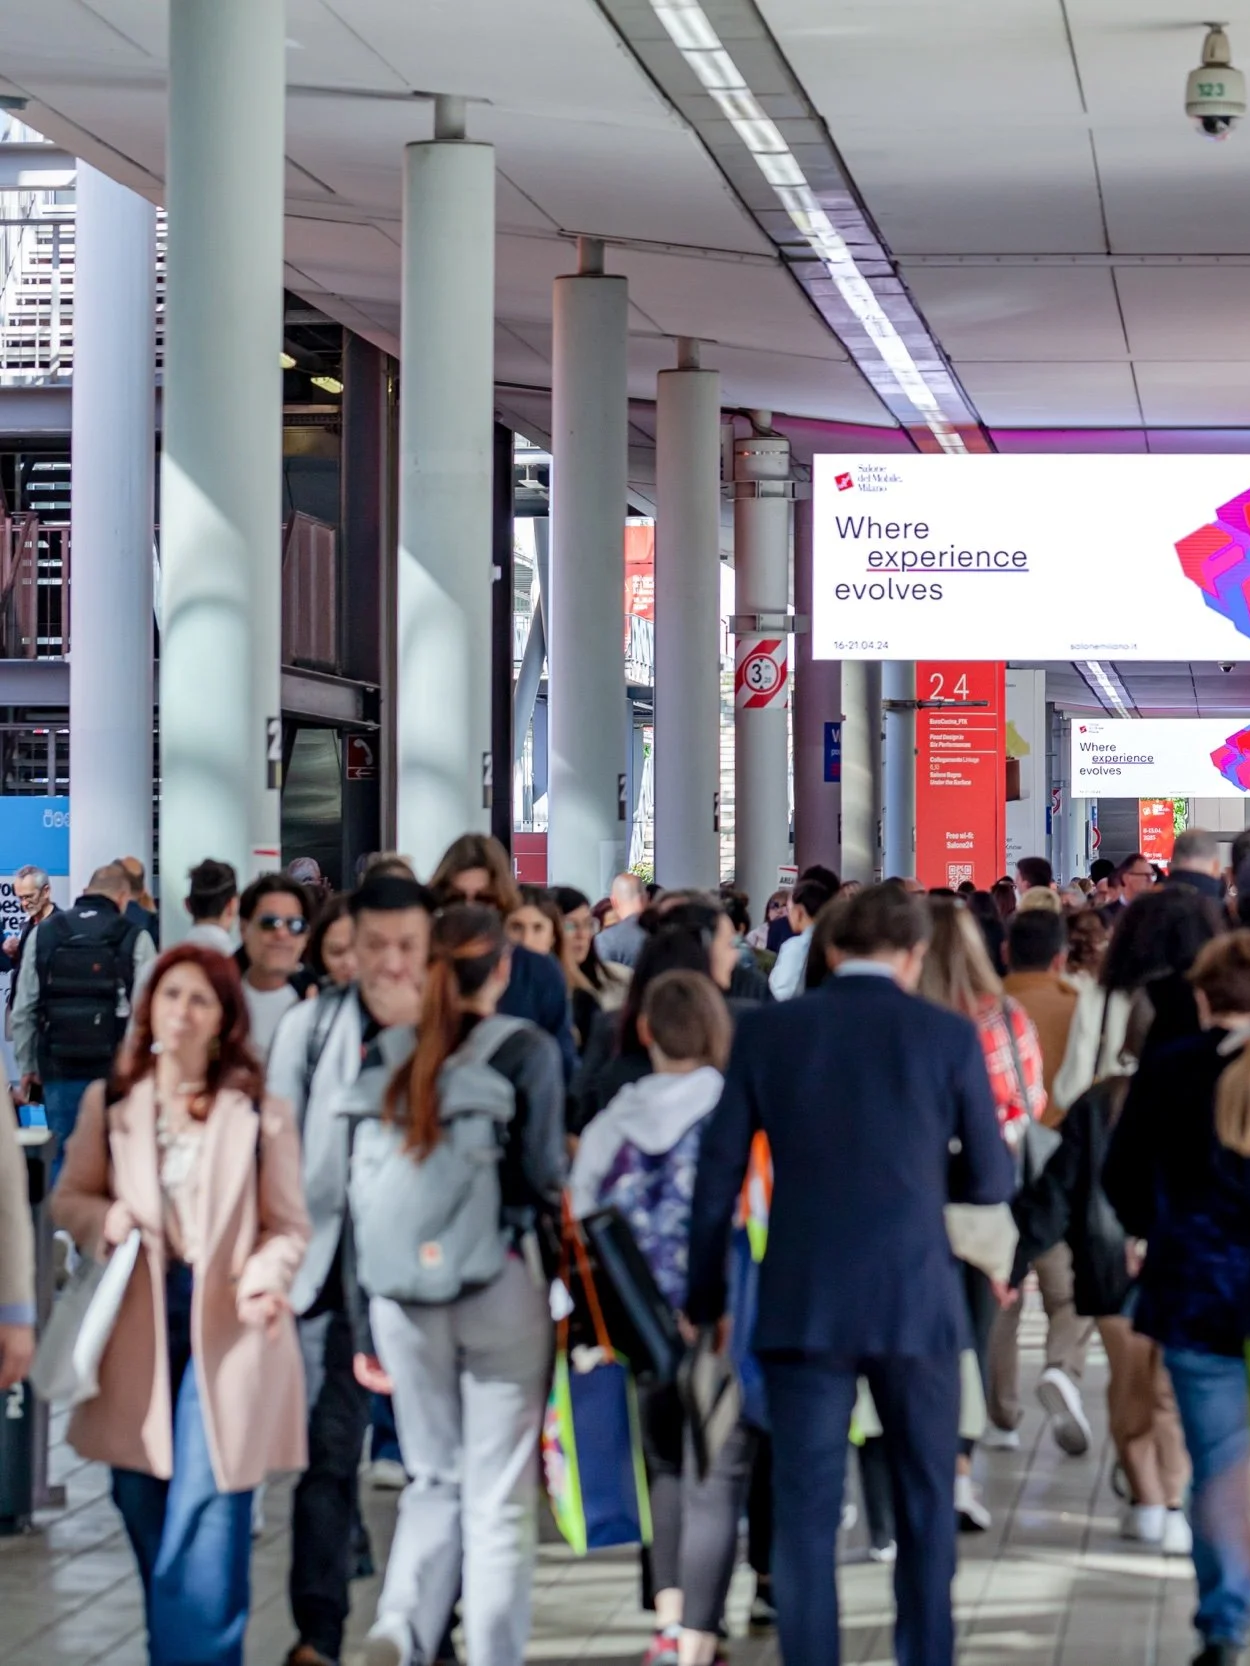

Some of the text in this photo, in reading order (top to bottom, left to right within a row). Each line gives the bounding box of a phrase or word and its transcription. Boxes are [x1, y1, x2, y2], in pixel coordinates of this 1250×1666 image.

[835, 516, 930, 539] Where
[868, 544, 1027, 572] experience
[835, 577, 943, 600] evolves
[1080, 742, 1117, 752] Where
[1092, 752, 1155, 764] experience
[1079, 766, 1122, 776] evolves
[945, 832, 960, 840] Free
[946, 841, 974, 849] Salone24
